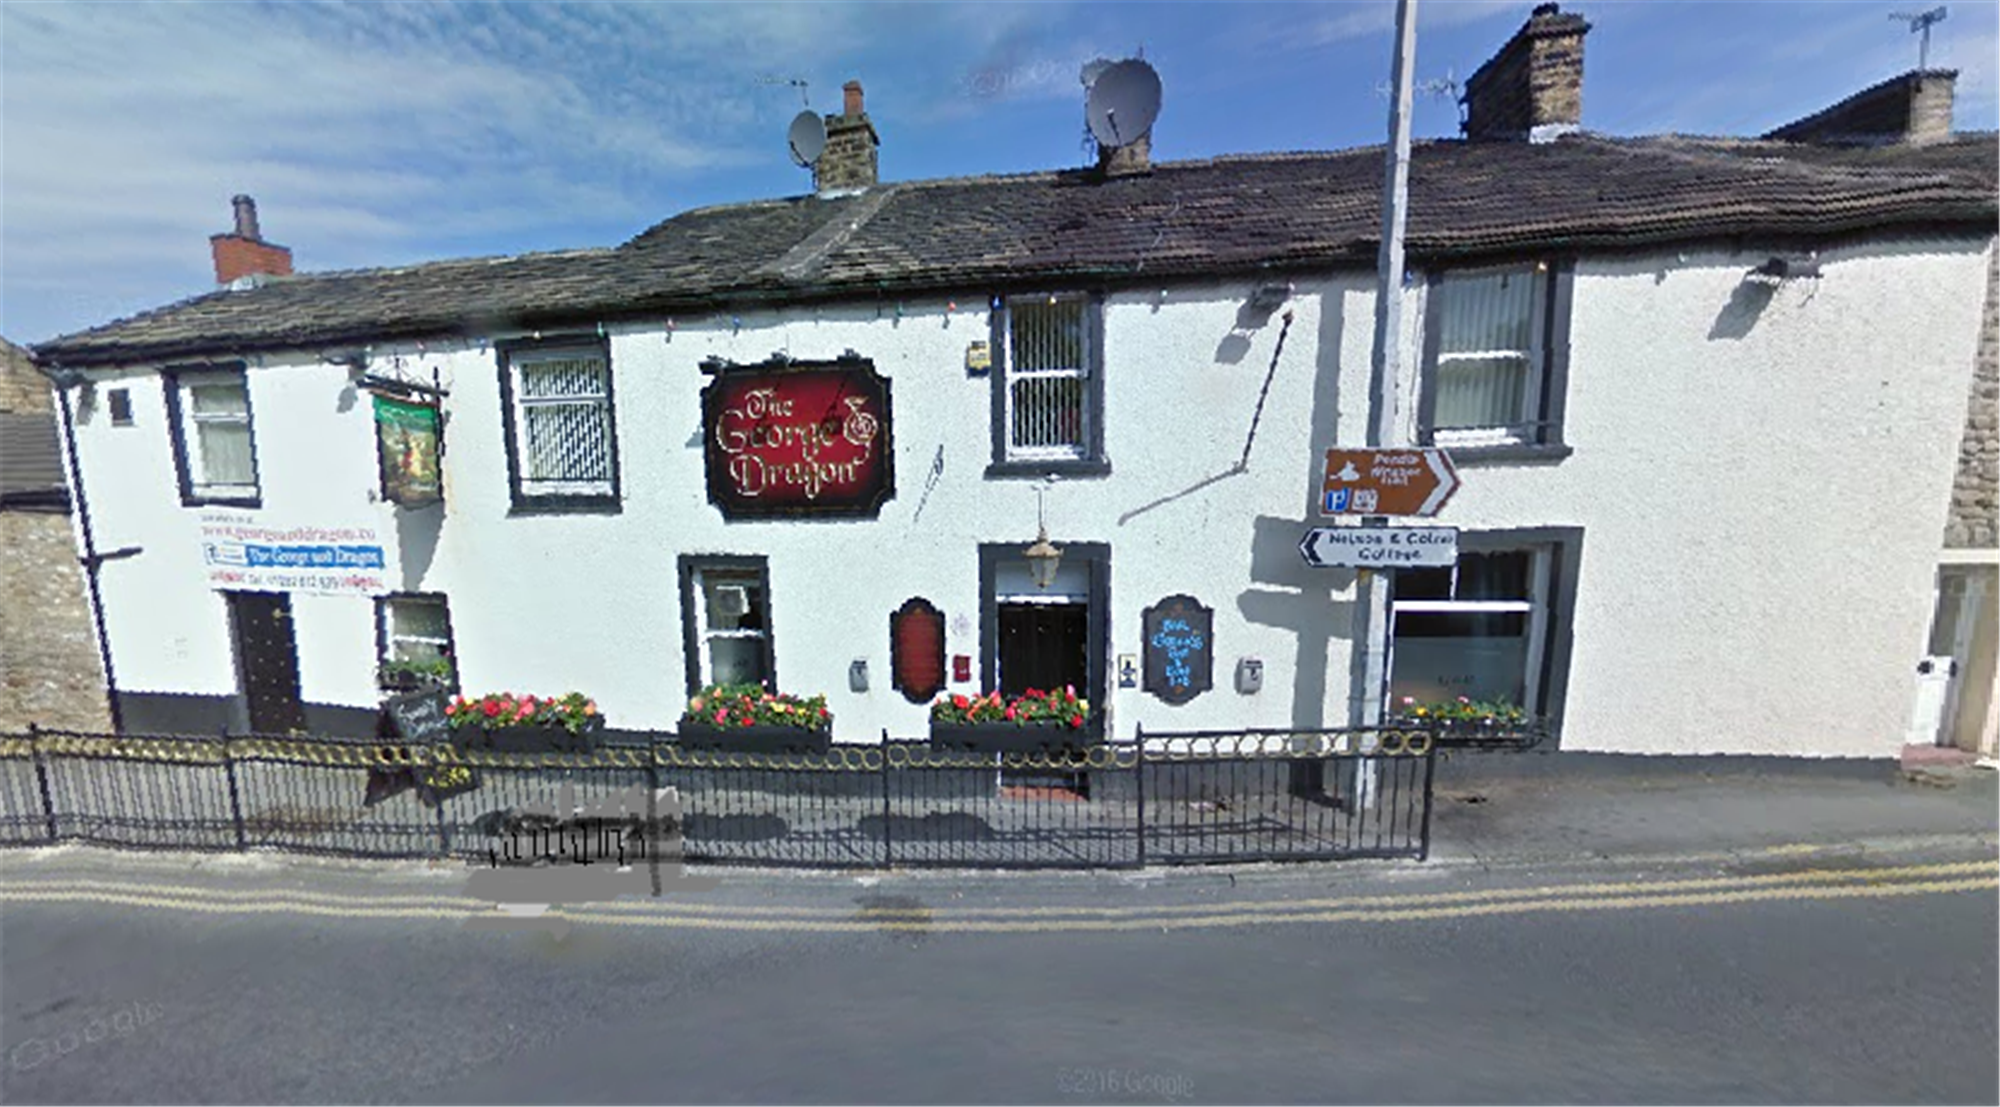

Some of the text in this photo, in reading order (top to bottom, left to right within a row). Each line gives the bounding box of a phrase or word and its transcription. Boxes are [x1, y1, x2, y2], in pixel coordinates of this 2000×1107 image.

[744, 388, 794, 419] The
[716, 409, 838, 462] George
[729, 454, 858, 500] Dragon
[1329, 532, 1383, 545] Nelson
[1390, 533, 1401, 545] &
[1358, 549, 1422, 561] College
